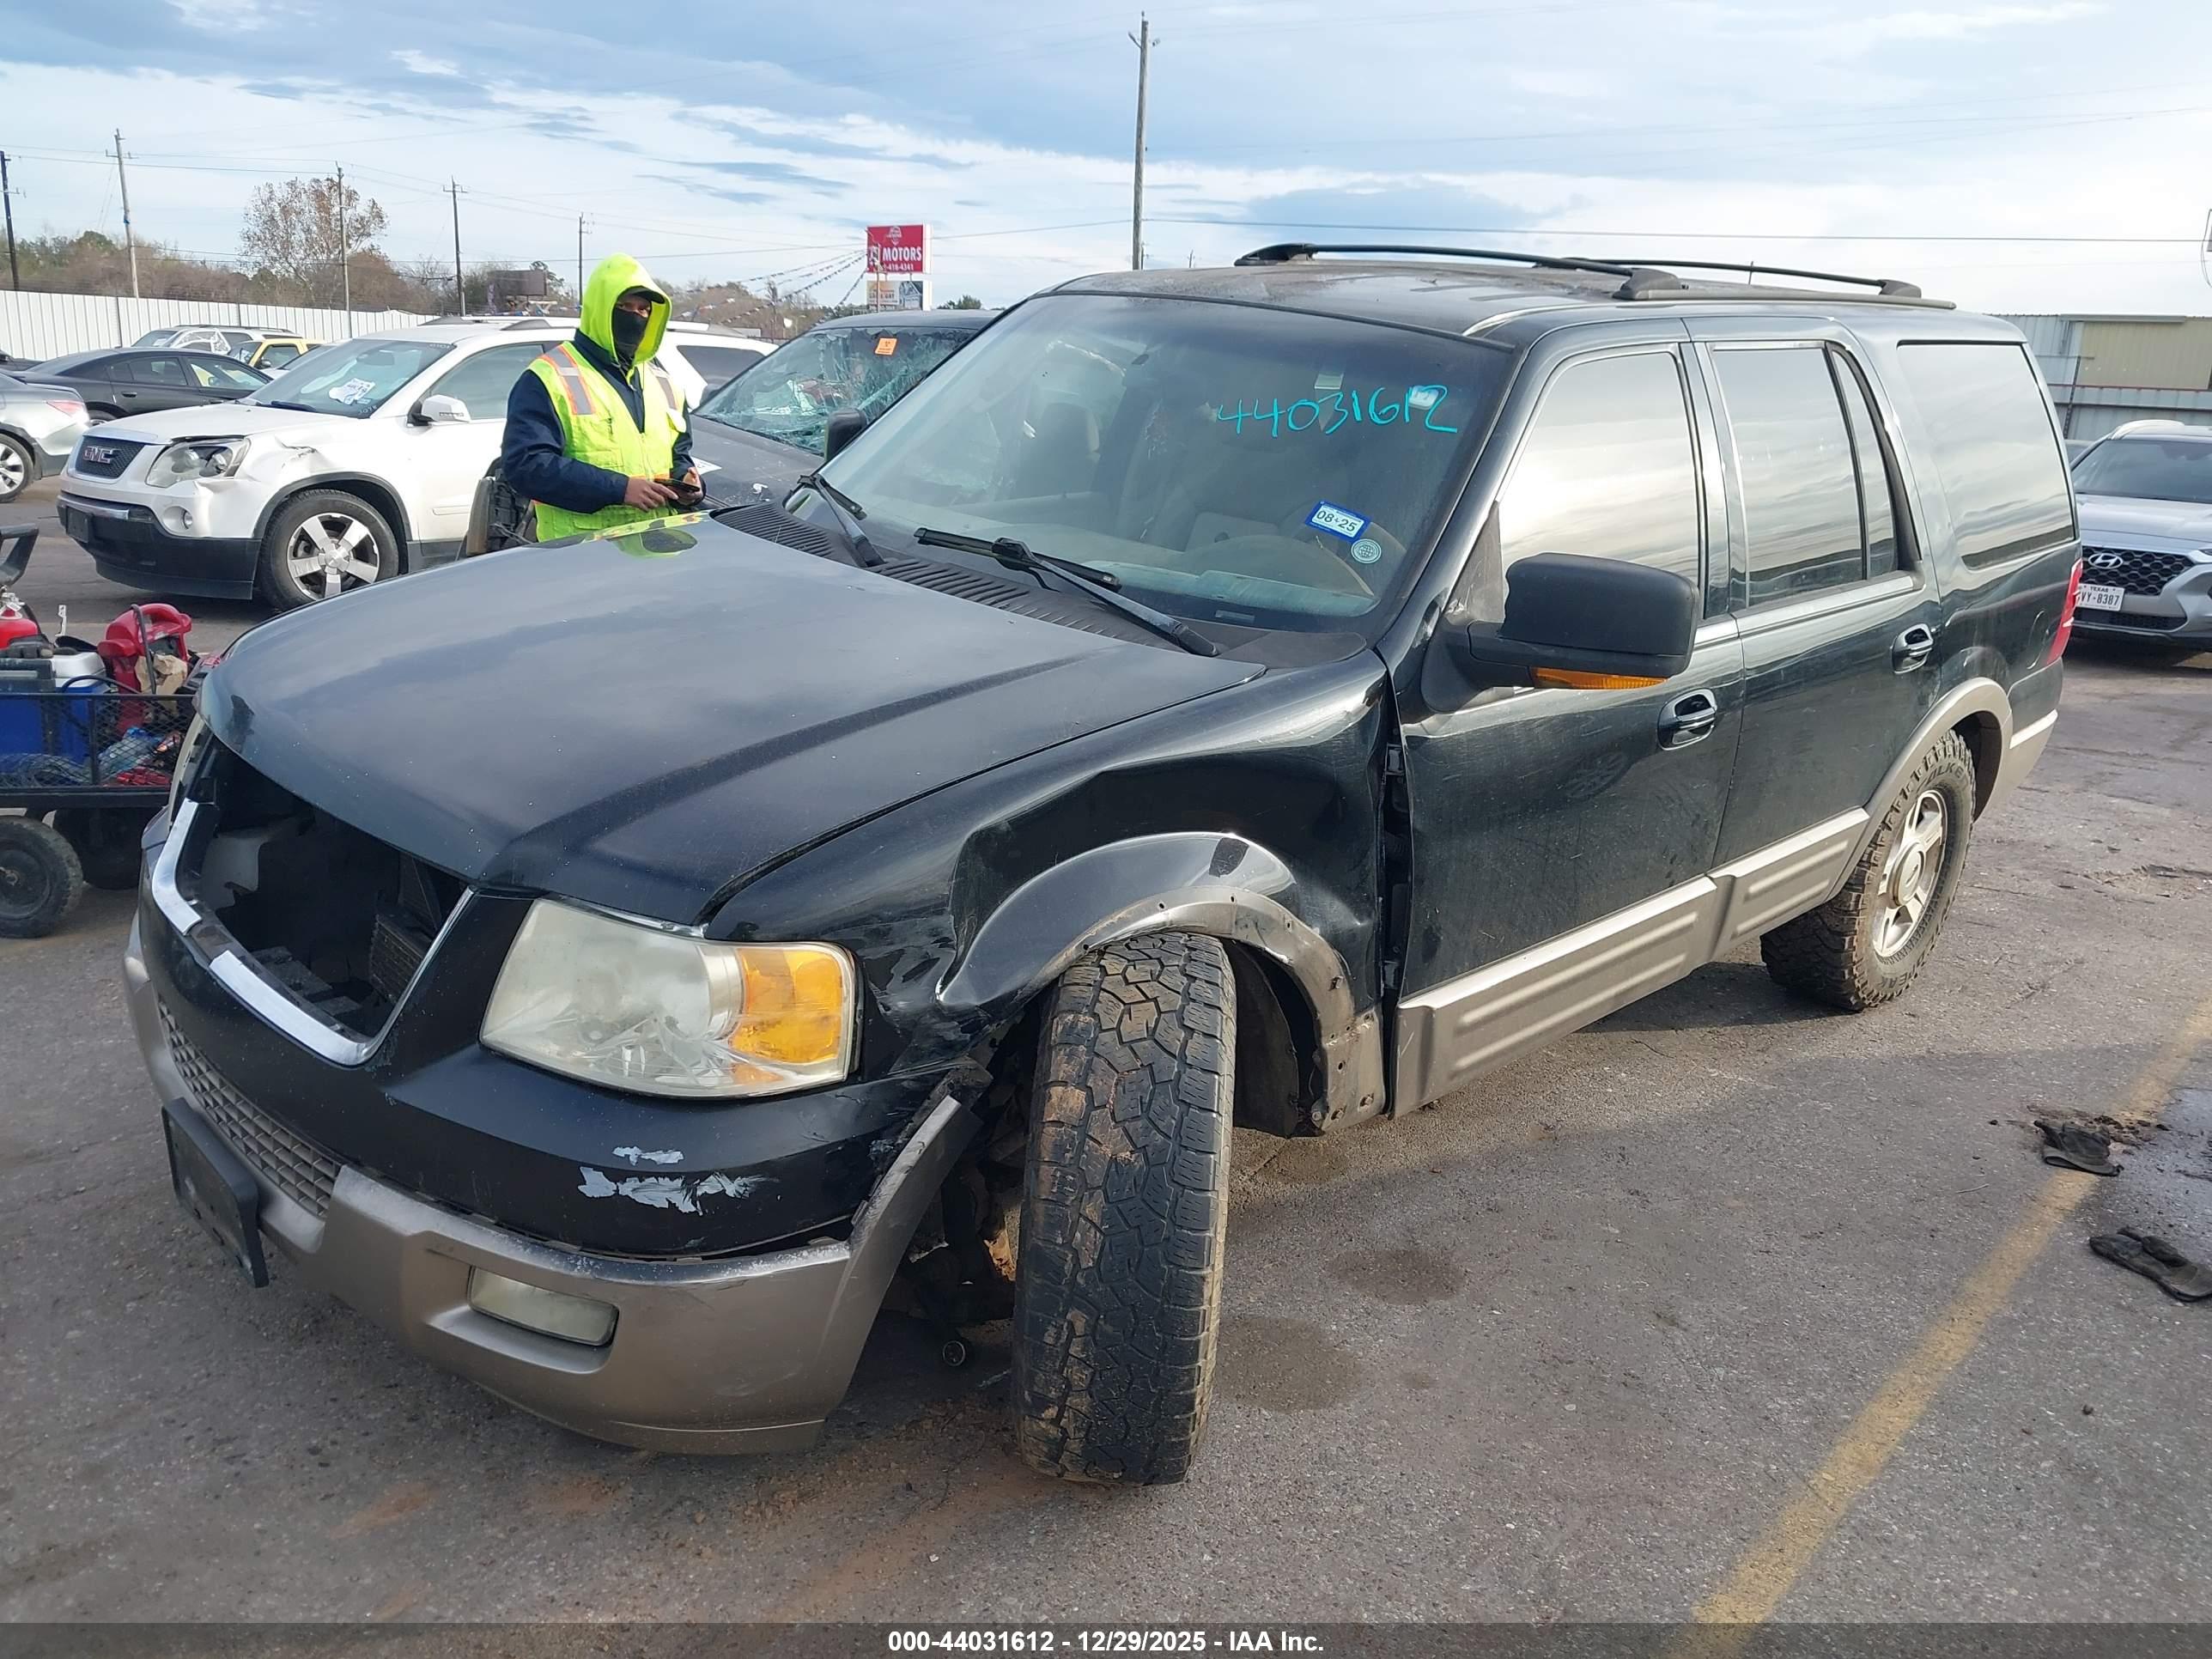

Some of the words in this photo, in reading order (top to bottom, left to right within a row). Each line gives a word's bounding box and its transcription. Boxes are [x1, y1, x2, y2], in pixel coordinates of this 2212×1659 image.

[883, 246, 921, 261] MOTORS
[1218, 385, 1458, 437] 44031612
[82, 446, 118, 464] GMC
